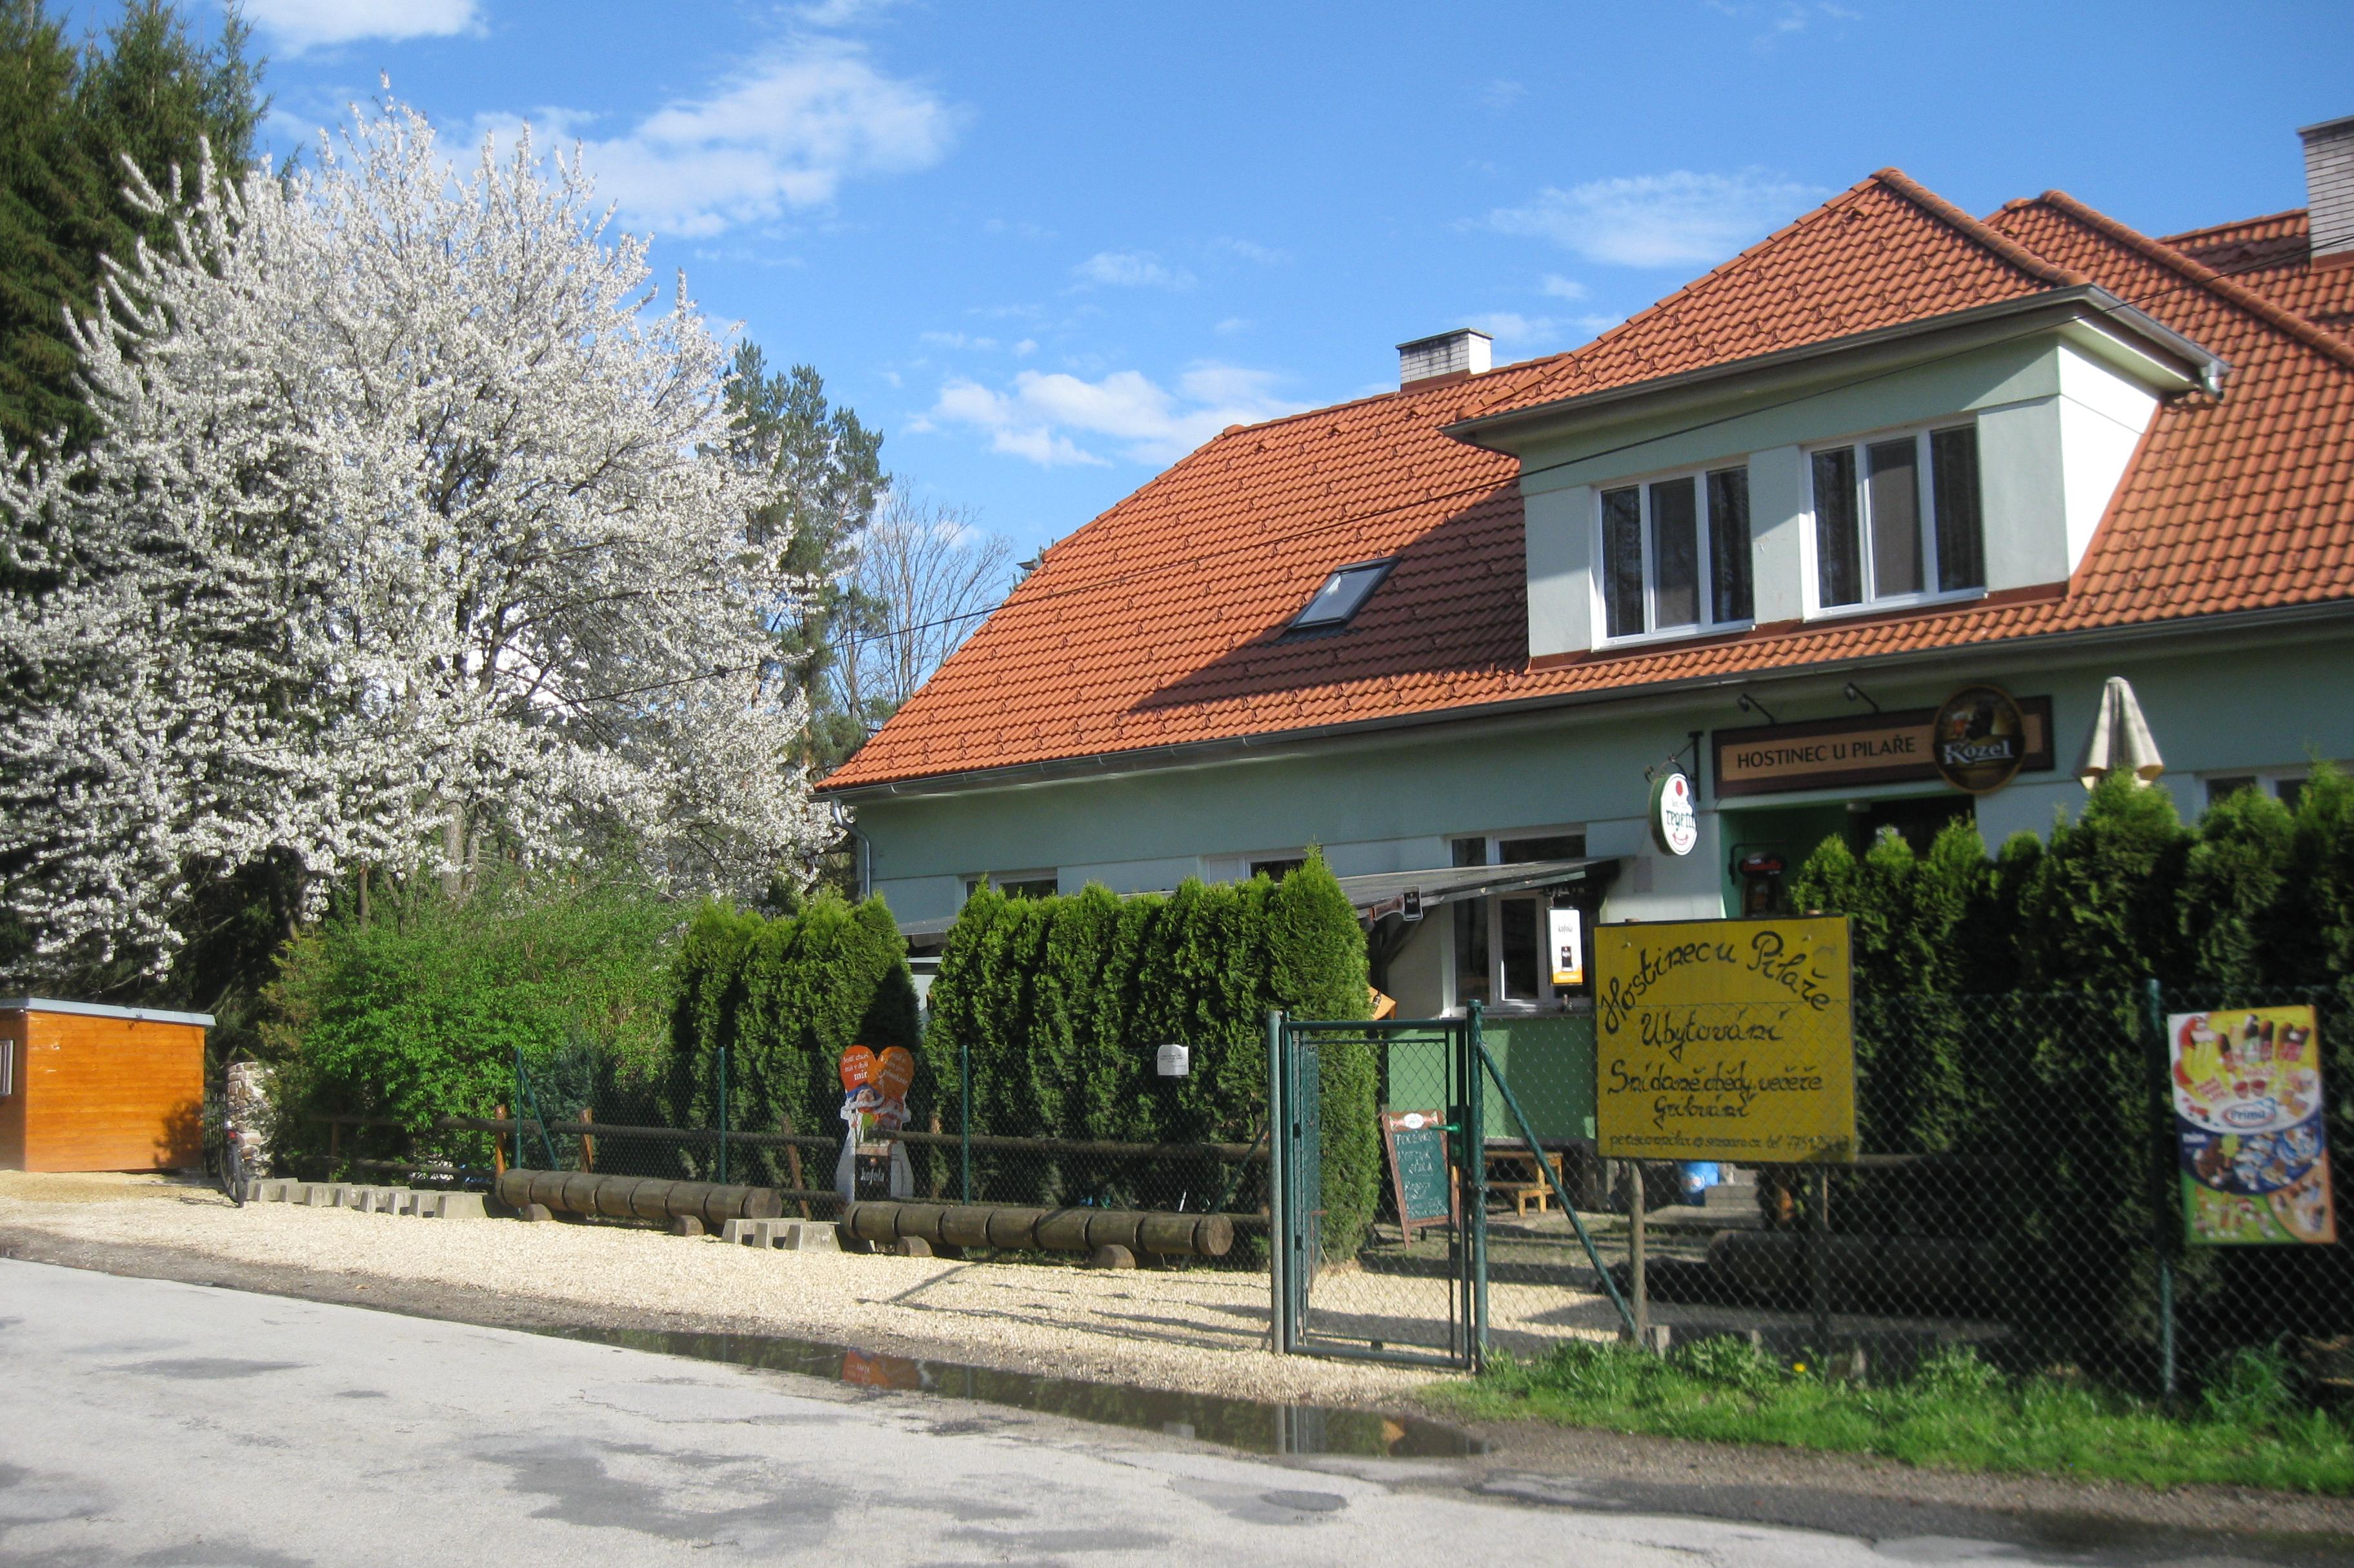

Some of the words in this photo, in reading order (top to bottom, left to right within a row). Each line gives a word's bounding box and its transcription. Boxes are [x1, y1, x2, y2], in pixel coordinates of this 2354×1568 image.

[1737, 745, 1827, 769] HOSTINEC
[1833, 743, 1846, 759] U
[1852, 733, 1916, 758] PILAŘE
[1944, 739, 2015, 765] Kozel
[1600, 942, 1711, 1035] Hostinec
[1747, 930, 1831, 1012] Pilaře
[1641, 1007, 1792, 1063] Ubytování
